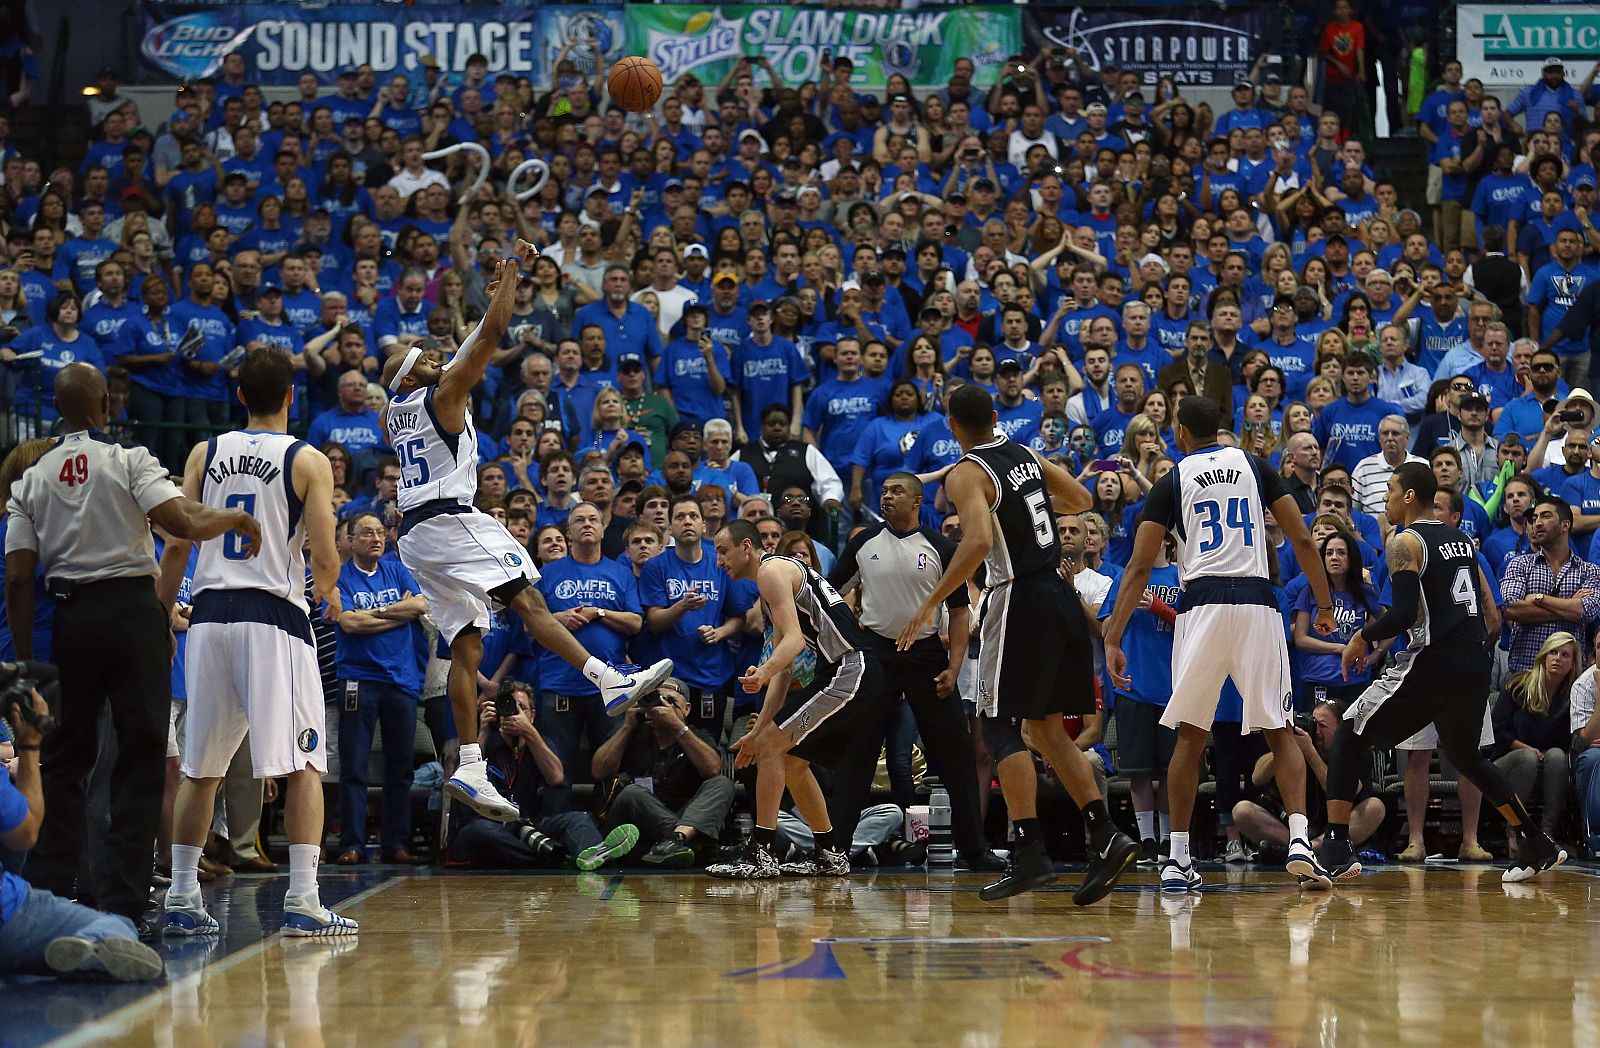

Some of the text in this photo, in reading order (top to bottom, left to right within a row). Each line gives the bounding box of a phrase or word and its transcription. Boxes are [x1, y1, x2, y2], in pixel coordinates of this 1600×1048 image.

[173, 26, 235, 41] BUD
[744, 10, 948, 45] SLAM DUNK
[1486, 14, 1600, 49] Amic
[256, 21, 533, 72] SOUND STAGE
[655, 26, 736, 74] Sprite
[1104, 36, 1249, 62] STARPOWER
[760, 45, 873, 82] ZONE
[389, 412, 418, 435] CARTER
[1345, 424, 1374, 435] MFFL
[1345, 434, 1374, 442] STRONG
[59, 454, 88, 488] 49
[208, 455, 281, 486] CALDERON
[1007, 462, 1042, 491] JOSEPH
[1194, 469, 1242, 489] WRIGHT
[1023, 488, 1055, 548] 5
[1193, 497, 1255, 552] 34
[1439, 541, 1473, 561] GREEN
[576, 580, 616, 593] MFFL
[577, 590, 616, 601] STRONG
[682, 579, 719, 593] MFFL
[1450, 566, 1478, 616] 4
